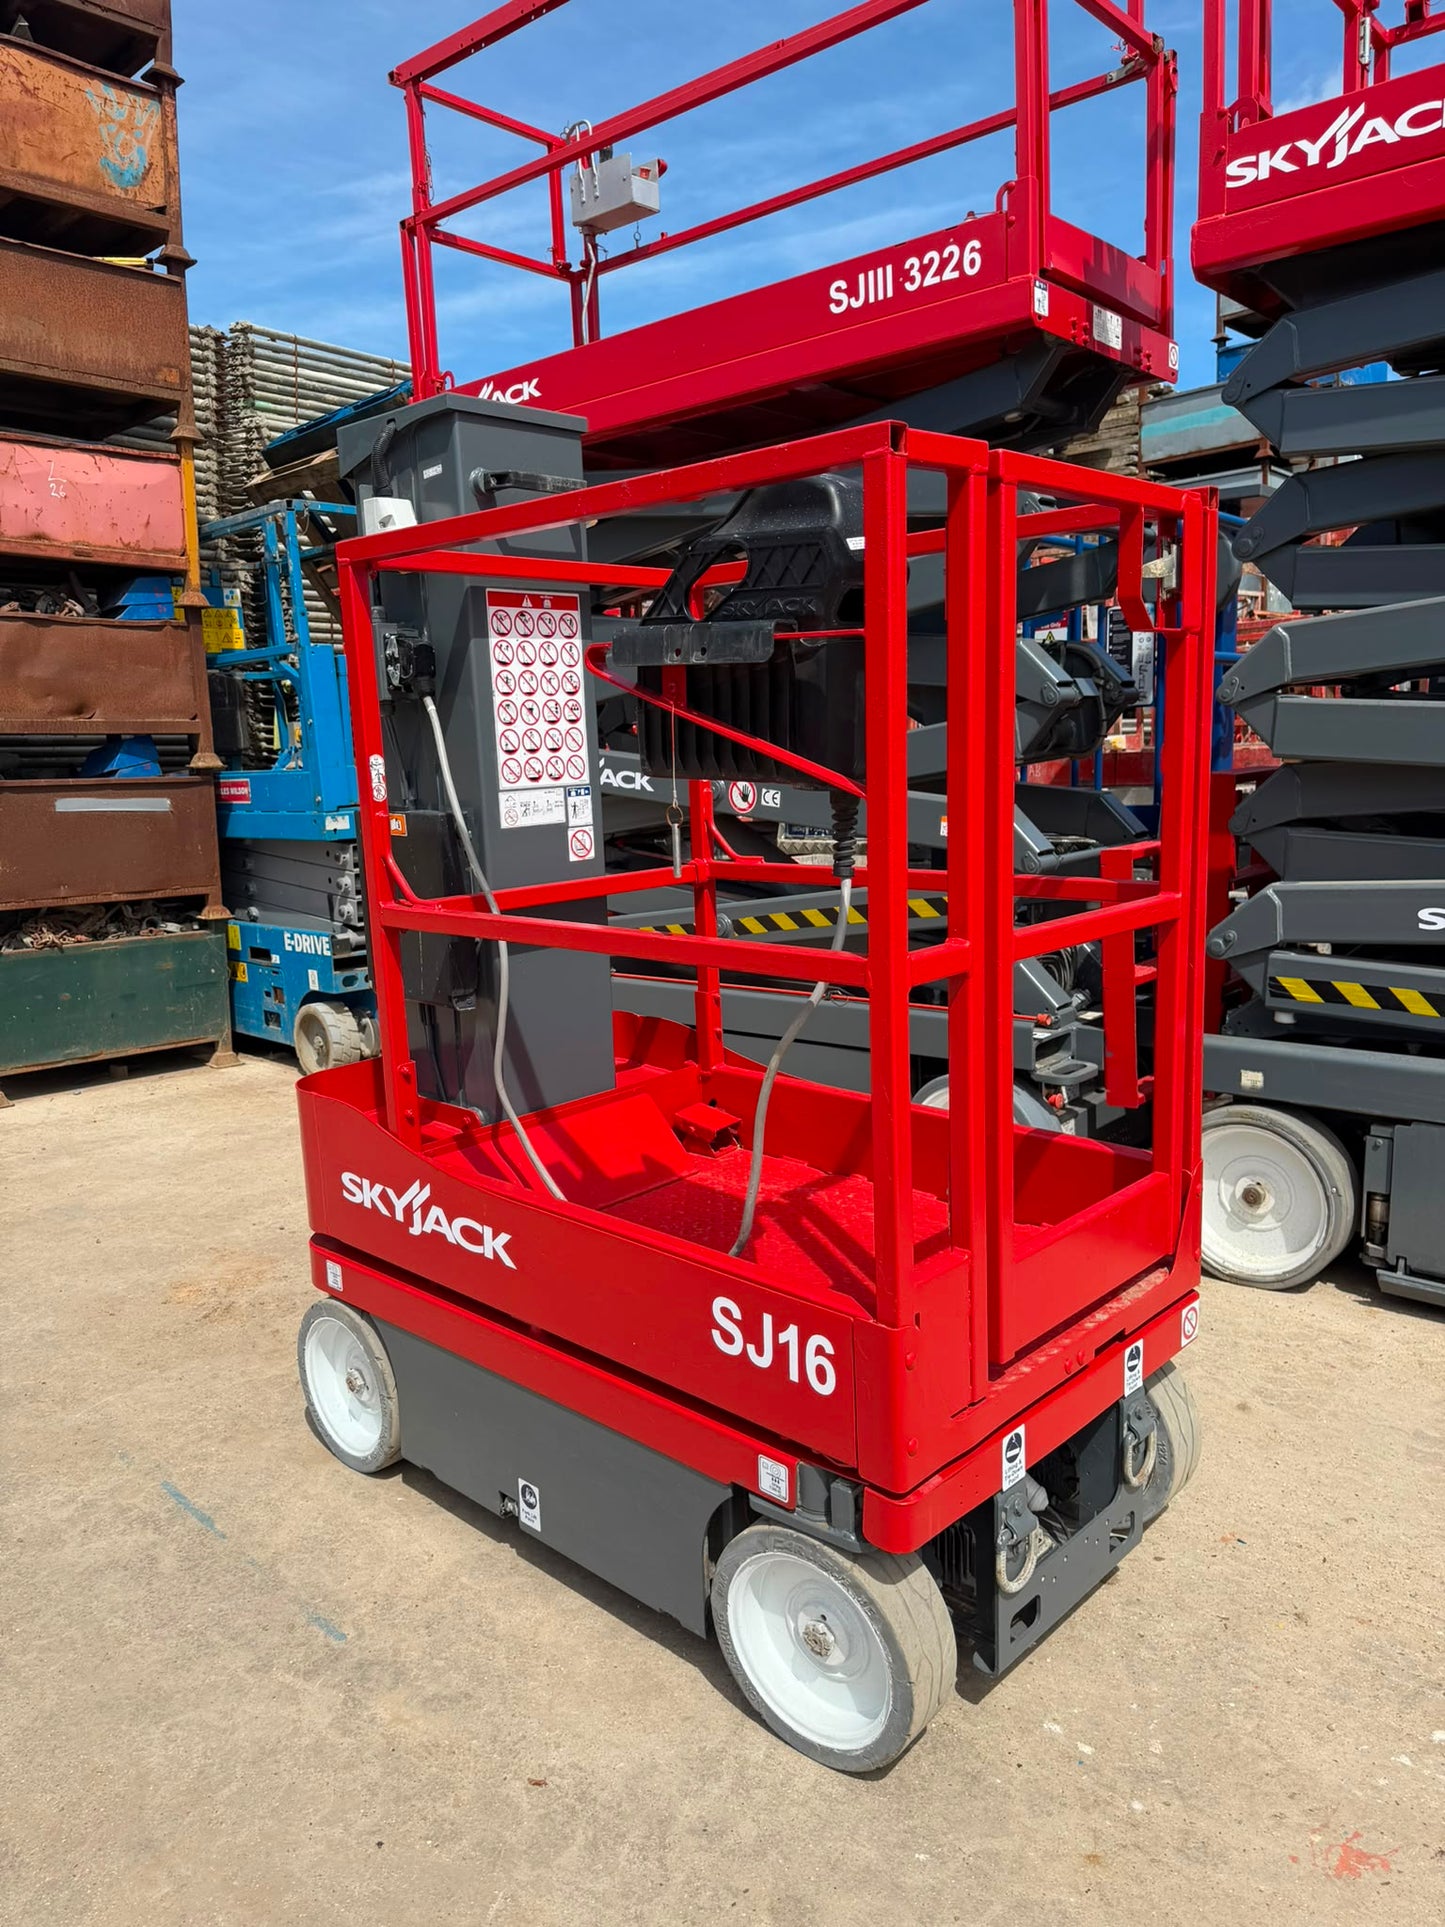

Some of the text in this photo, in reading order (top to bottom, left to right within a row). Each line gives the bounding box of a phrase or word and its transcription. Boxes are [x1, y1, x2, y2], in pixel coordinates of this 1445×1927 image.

[1225, 98, 1445, 188] SKYJAC
[829, 239, 982, 314] SJIII 3226
[599, 757, 655, 792] ACK
[284, 930, 332, 957] E-DRIVE
[341, 1171, 517, 1270] SKYJACK
[711, 1296, 837, 1396] SJ16
